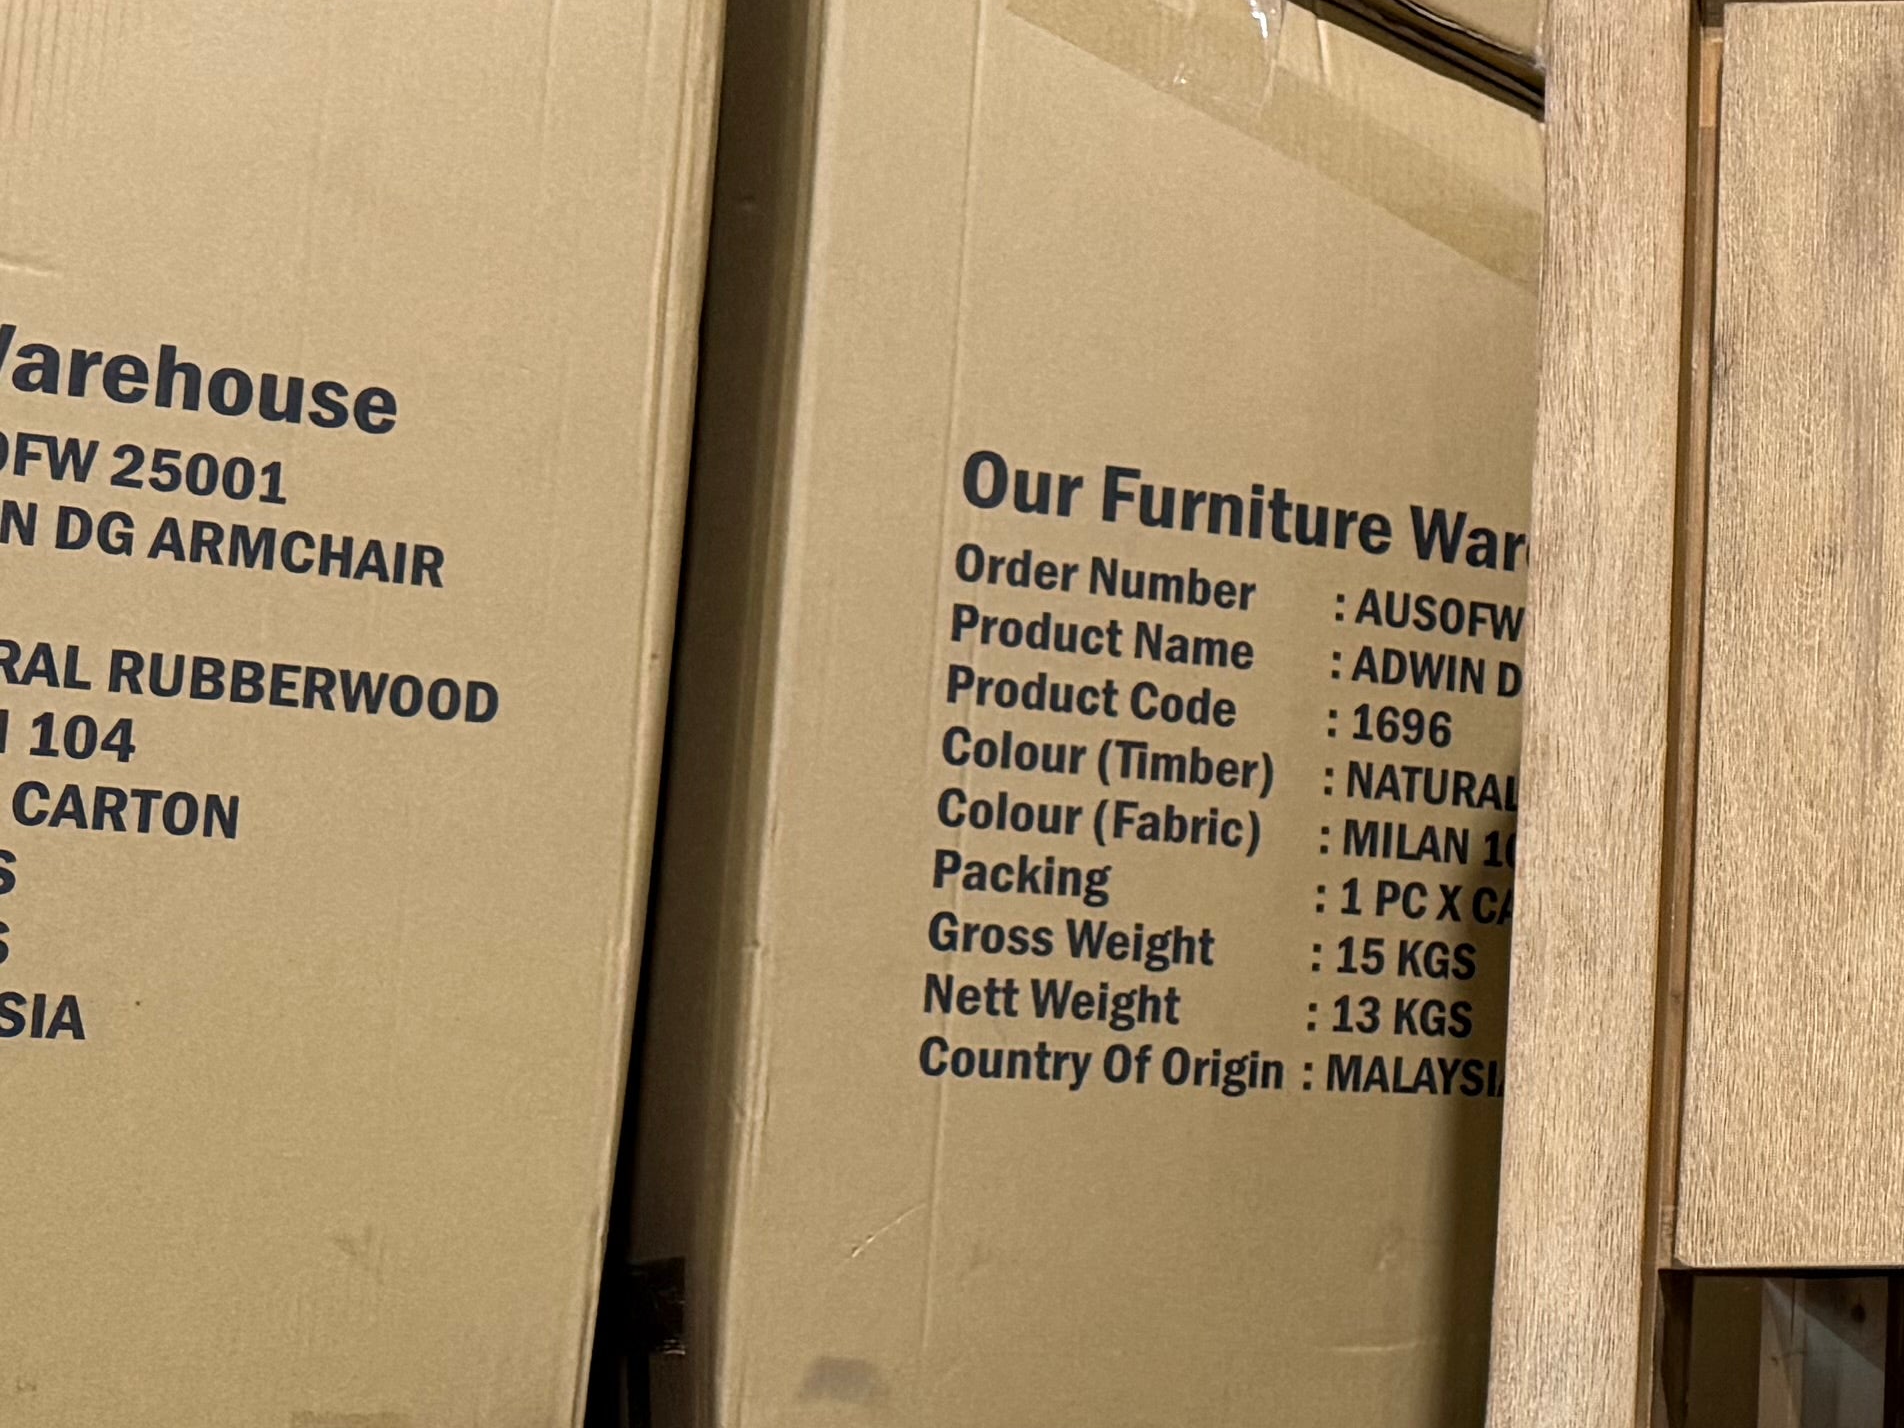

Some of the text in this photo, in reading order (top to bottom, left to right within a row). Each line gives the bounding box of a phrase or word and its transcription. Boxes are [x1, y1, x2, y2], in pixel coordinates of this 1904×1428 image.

[109, 443, 287, 506] 25001
[962, 444, 1085, 516] Our
[1102, 462, 1393, 556] Furniture
[55, 505, 135, 557] DG
[146, 516, 445, 589] ARMCHAIR
[955, 538, 1527, 641] Order Number AUSOFW
[107, 648, 500, 724] RUBBERWOOD
[948, 660, 1453, 748] Product Code 1696
[29, 711, 137, 763] 104
[11, 780, 240, 840] CARTON
[928, 909, 1478, 979] Gross Weight 15 KGS
[923, 971, 1474, 1036] Nett Weight 13 KGS
